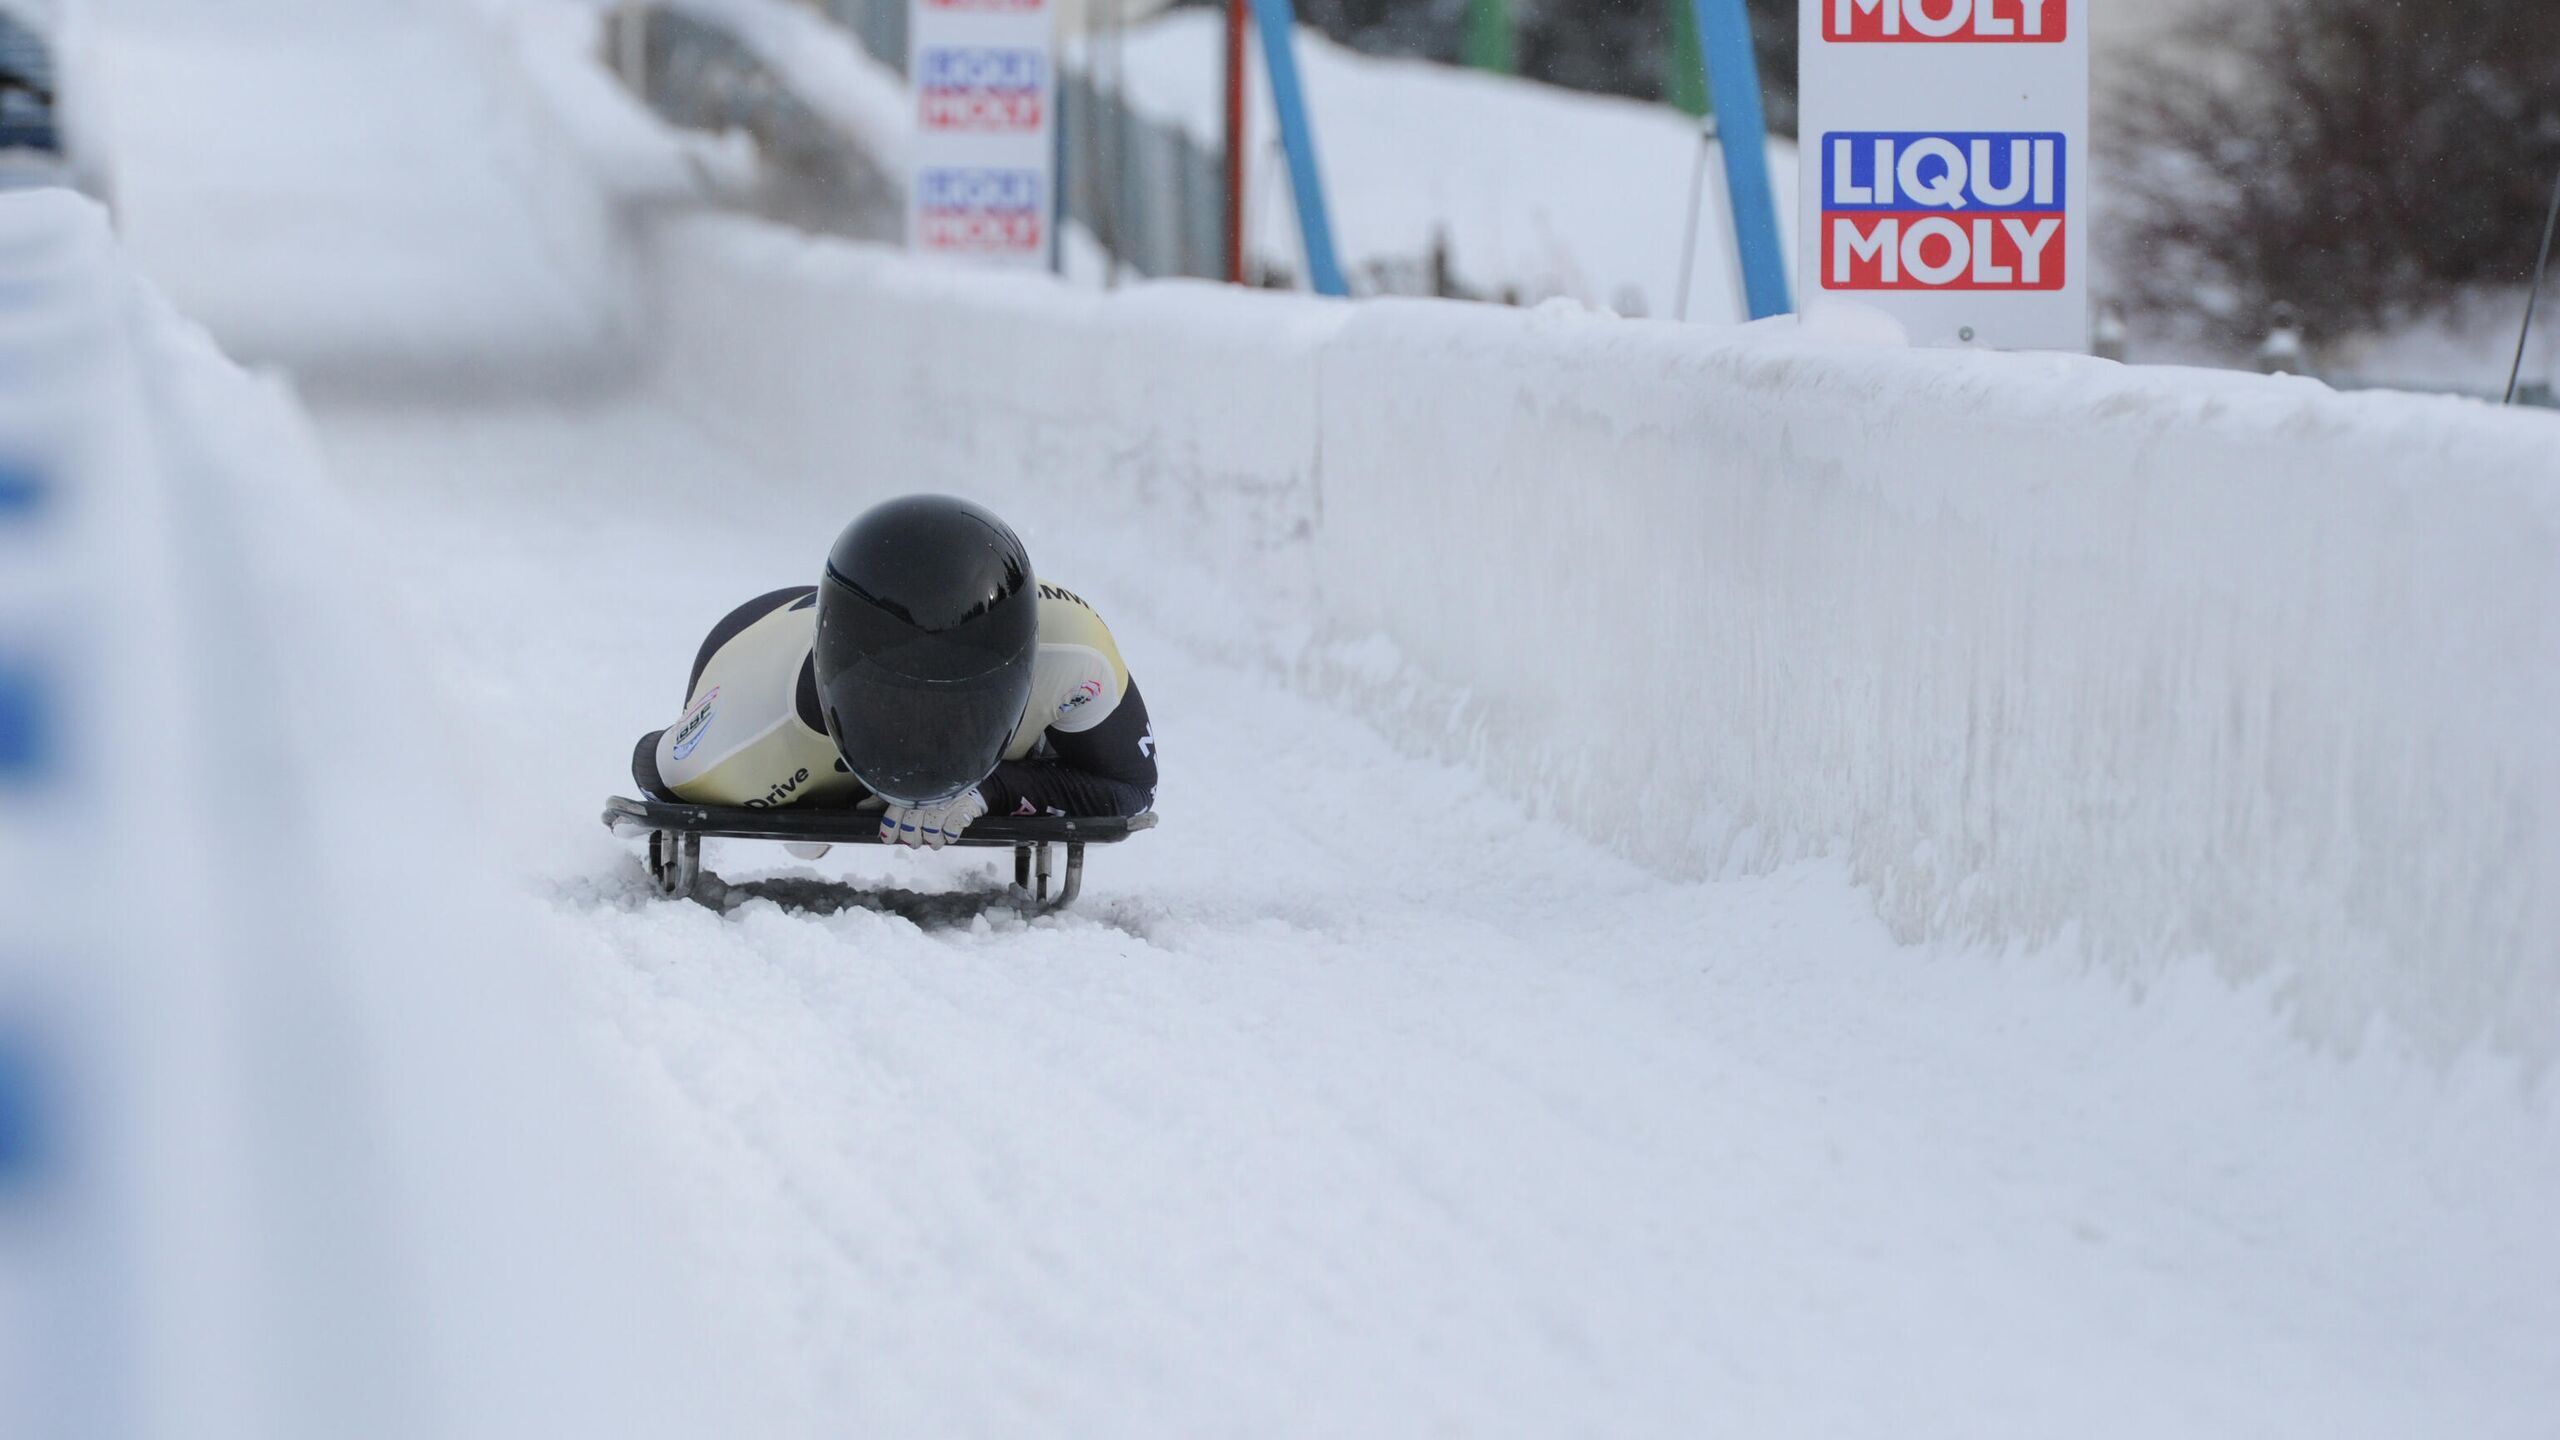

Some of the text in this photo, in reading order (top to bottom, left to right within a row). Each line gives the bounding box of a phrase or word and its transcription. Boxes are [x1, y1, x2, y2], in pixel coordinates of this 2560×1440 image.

[1834, 137, 2054, 210] LIQUI
[1833, 216, 2062, 285] MOLY
[744, 768, 809, 809] Drive
